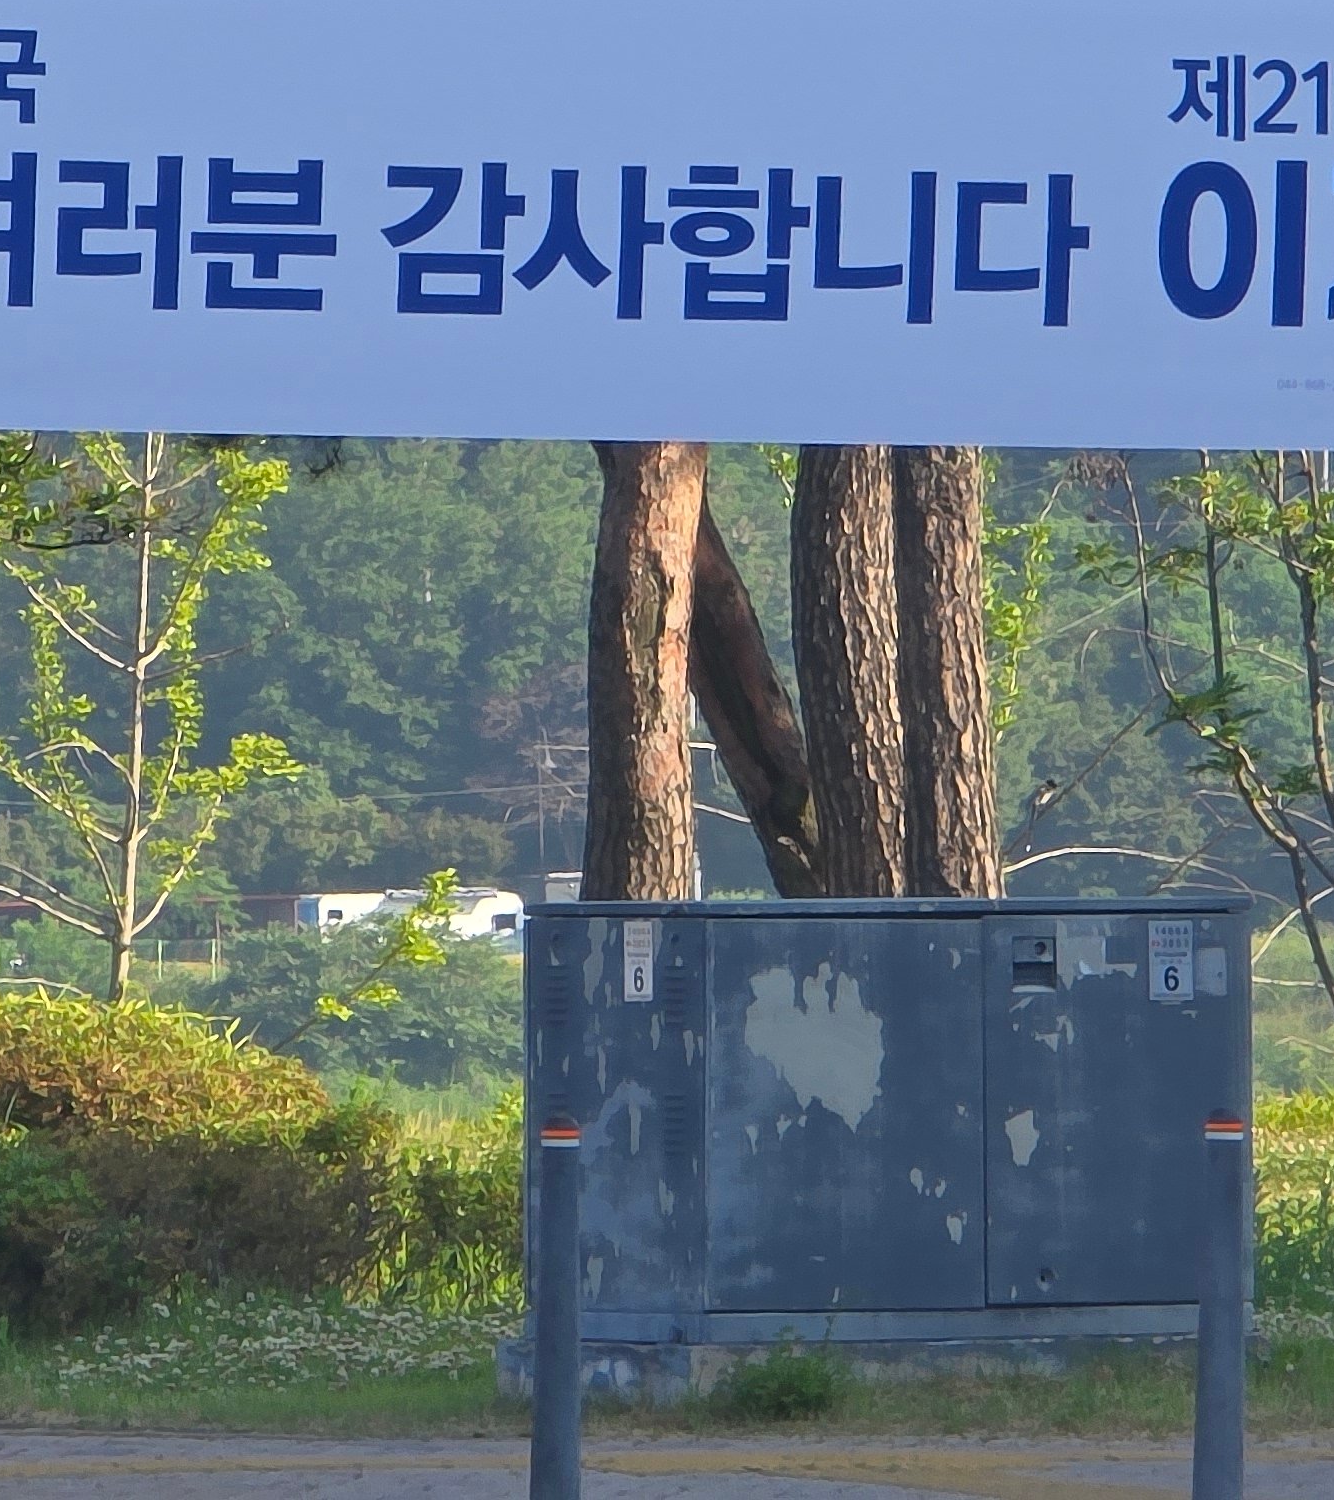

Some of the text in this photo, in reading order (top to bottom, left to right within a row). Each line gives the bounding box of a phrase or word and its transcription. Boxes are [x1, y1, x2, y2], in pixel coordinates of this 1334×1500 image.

[380, 162, 1090, 327] 감사합니다
[633, 965, 645, 993] 6
[1163, 965, 1180, 992] 6
